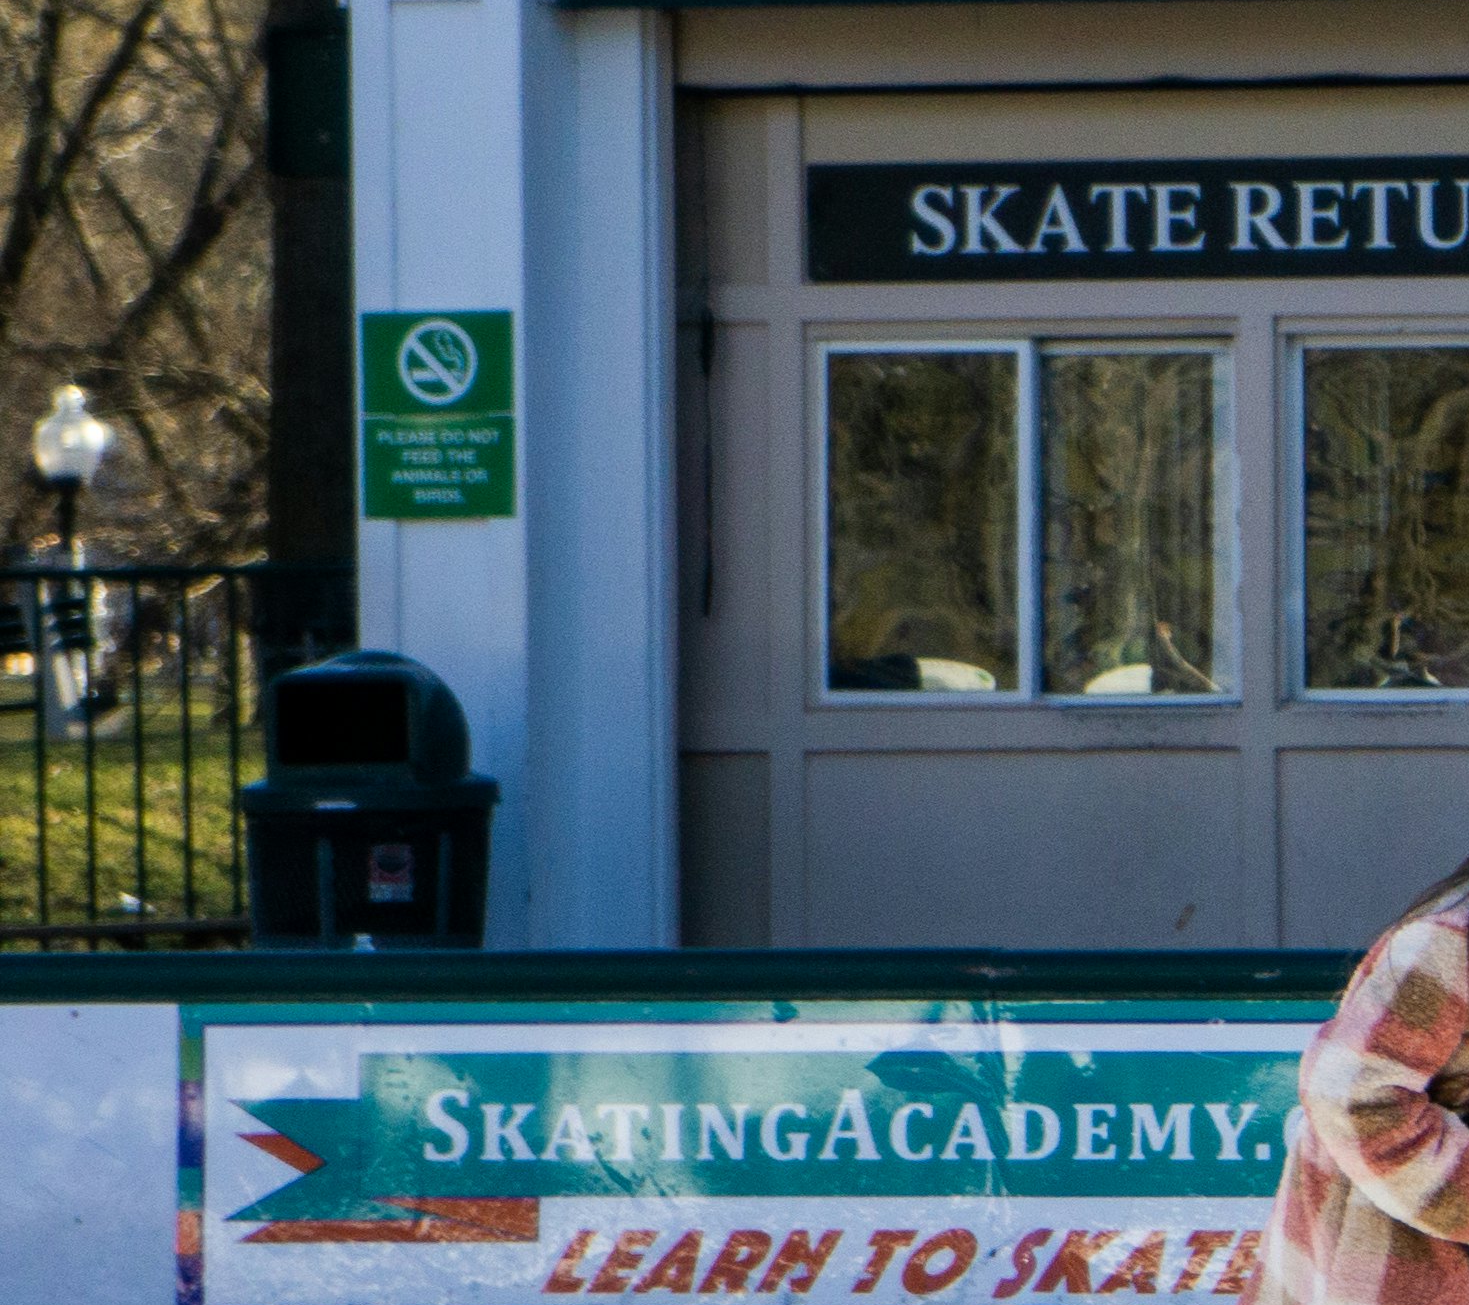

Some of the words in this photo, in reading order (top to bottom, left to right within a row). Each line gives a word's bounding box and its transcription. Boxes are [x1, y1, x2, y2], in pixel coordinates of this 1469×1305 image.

[909, 181, 1206, 256] SKATE
[377, 428, 437, 445] PLEASE
[440, 428, 465, 445] DO
[467, 428, 500, 445] NOT
[402, 448, 443, 464] FEED
[447, 448, 477, 464] THE
[392, 469, 461, 485] ANIMALS
[464, 468, 489, 484] OR
[541, 1229, 843, 1295] LEARN
[851, 1229, 979, 1295] TO
[992, 1228, 1263, 1296] SKATE
